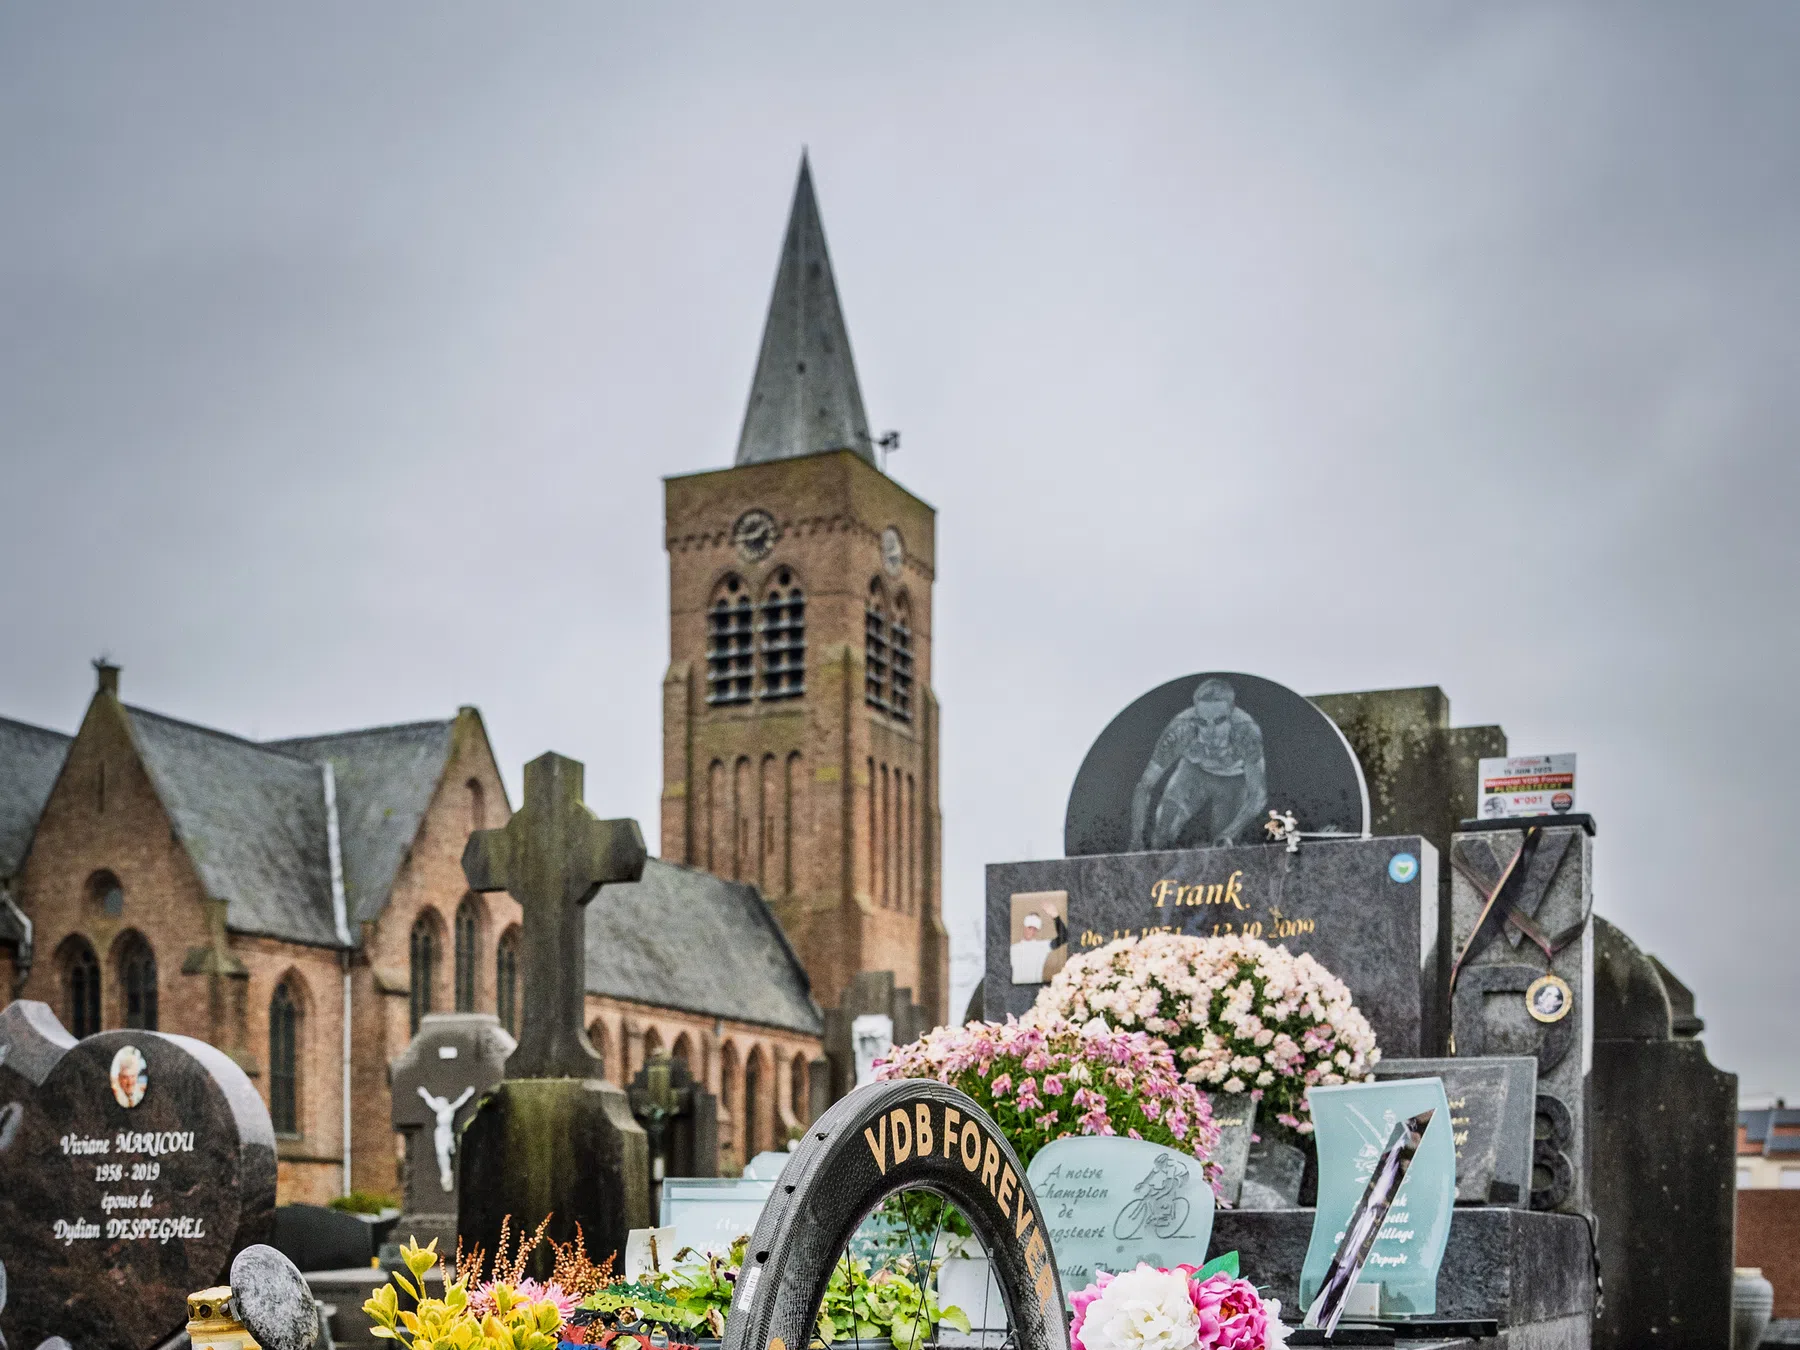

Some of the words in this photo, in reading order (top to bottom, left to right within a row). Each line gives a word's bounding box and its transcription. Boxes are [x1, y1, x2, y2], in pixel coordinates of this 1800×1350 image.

[59, 1132, 110, 1155] Viviane
[115, 1130, 195, 1157] MARICOU
[95, 1163, 123, 1182] 1958
[131, 1162, 161, 1181] 2019
[1066, 1166, 1103, 1180] notre
[101, 1190, 138, 1215] épouse
[139, 1188, 154, 1209] de
[1034, 1183, 1109, 1204] Champion
[864, 1103, 934, 1176] VDB
[943, 1105, 1054, 1316] FOREVER
[1058, 1203, 1074, 1219] de
[106, 1215, 206, 1245] DESPEGHEL
[1049, 1226, 1106, 1243] egsteert
